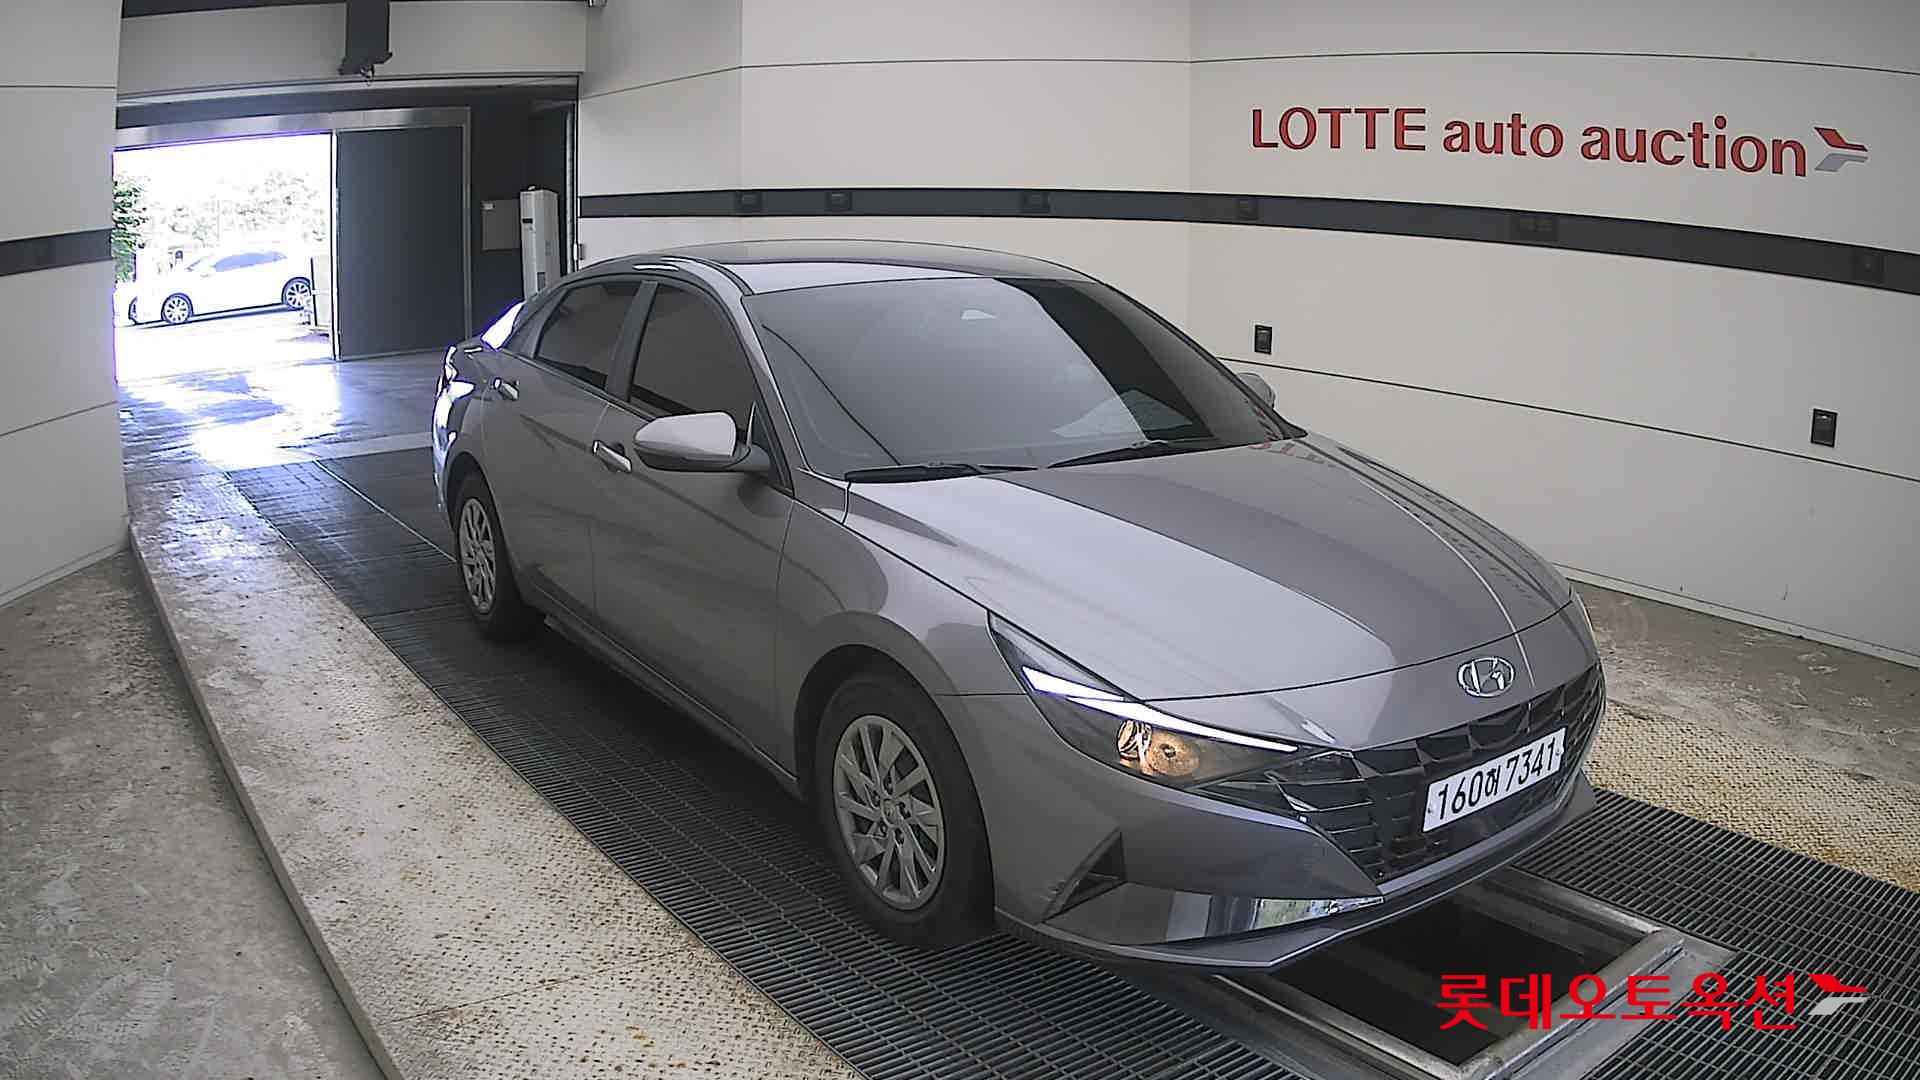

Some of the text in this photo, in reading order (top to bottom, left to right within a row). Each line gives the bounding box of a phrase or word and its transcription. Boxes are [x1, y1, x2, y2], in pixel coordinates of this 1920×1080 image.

[1252, 107, 1808, 177] LOTTE auto auction
[1506, 737, 1556, 792] 7341
